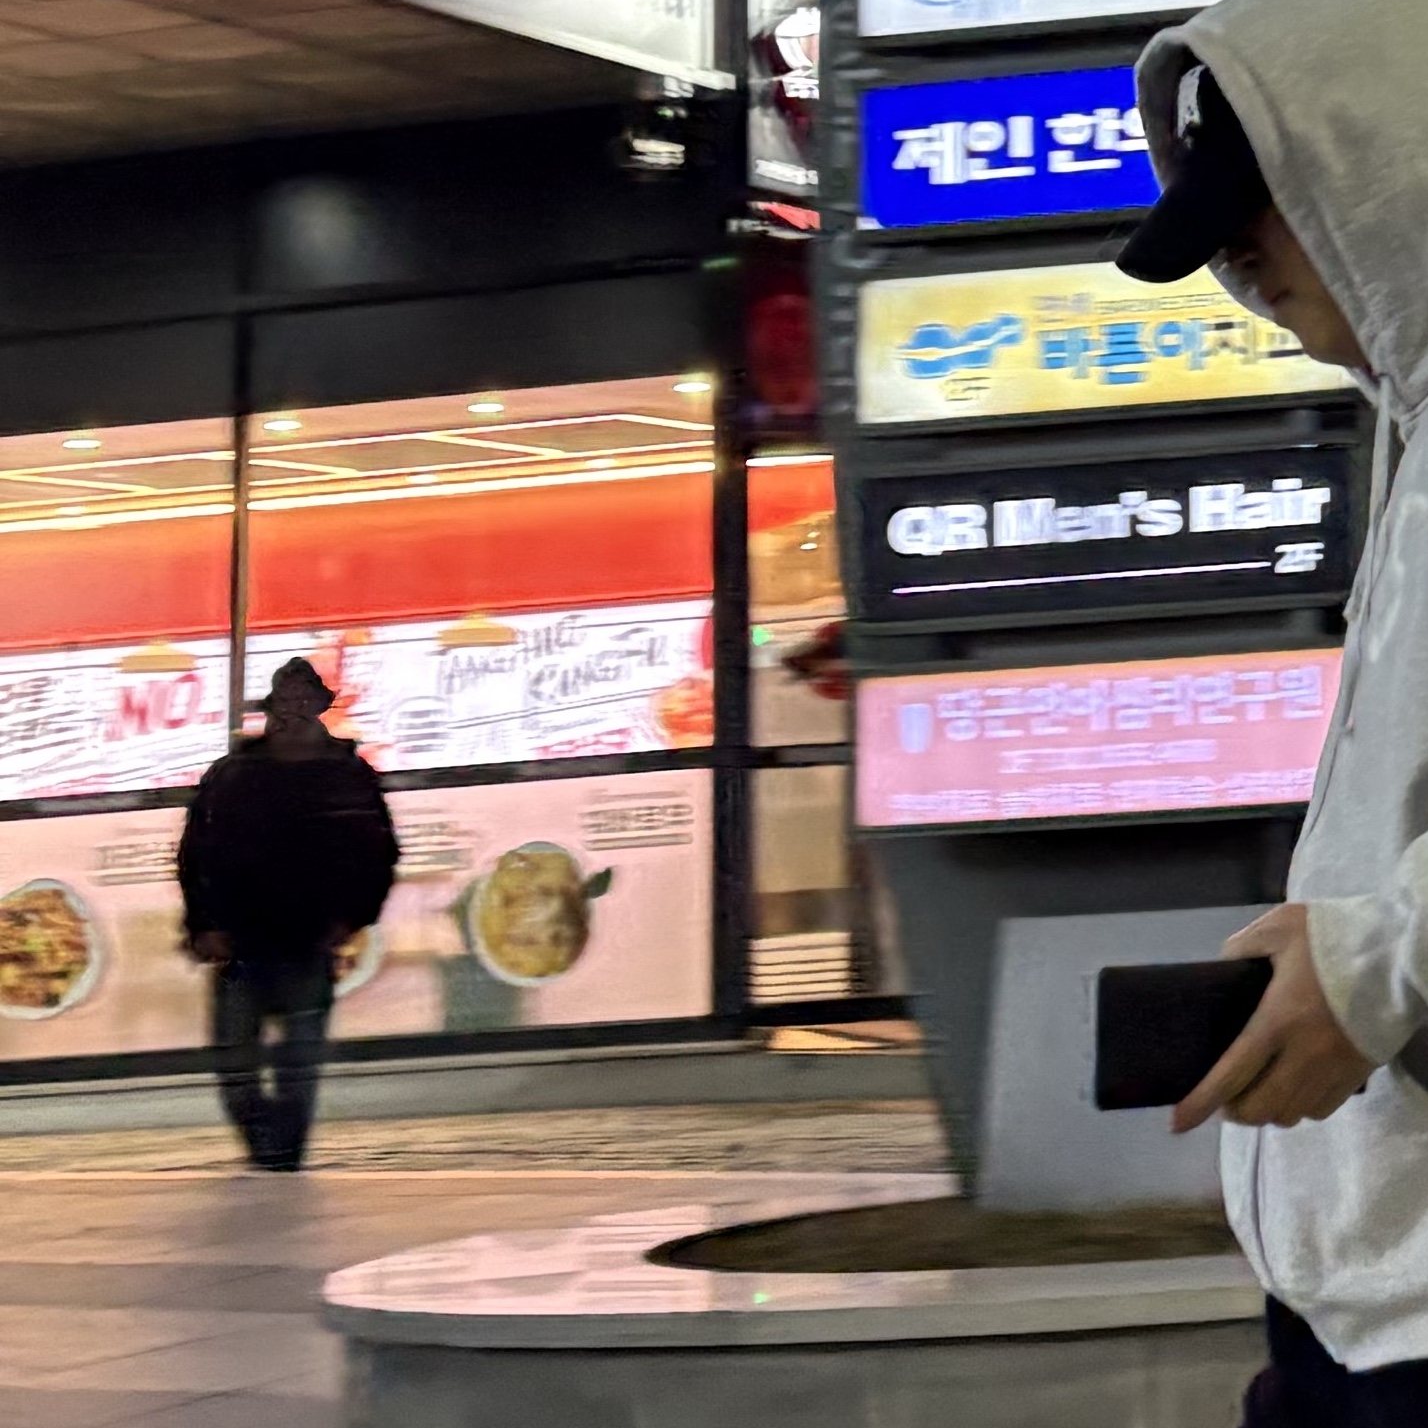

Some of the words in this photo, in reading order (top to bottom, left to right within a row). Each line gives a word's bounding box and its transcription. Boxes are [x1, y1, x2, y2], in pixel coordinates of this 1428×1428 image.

[891, 115, 1036, 185] 제인
[993, 490, 1184, 547] Men's
[1189, 477, 1331, 534] Hair
